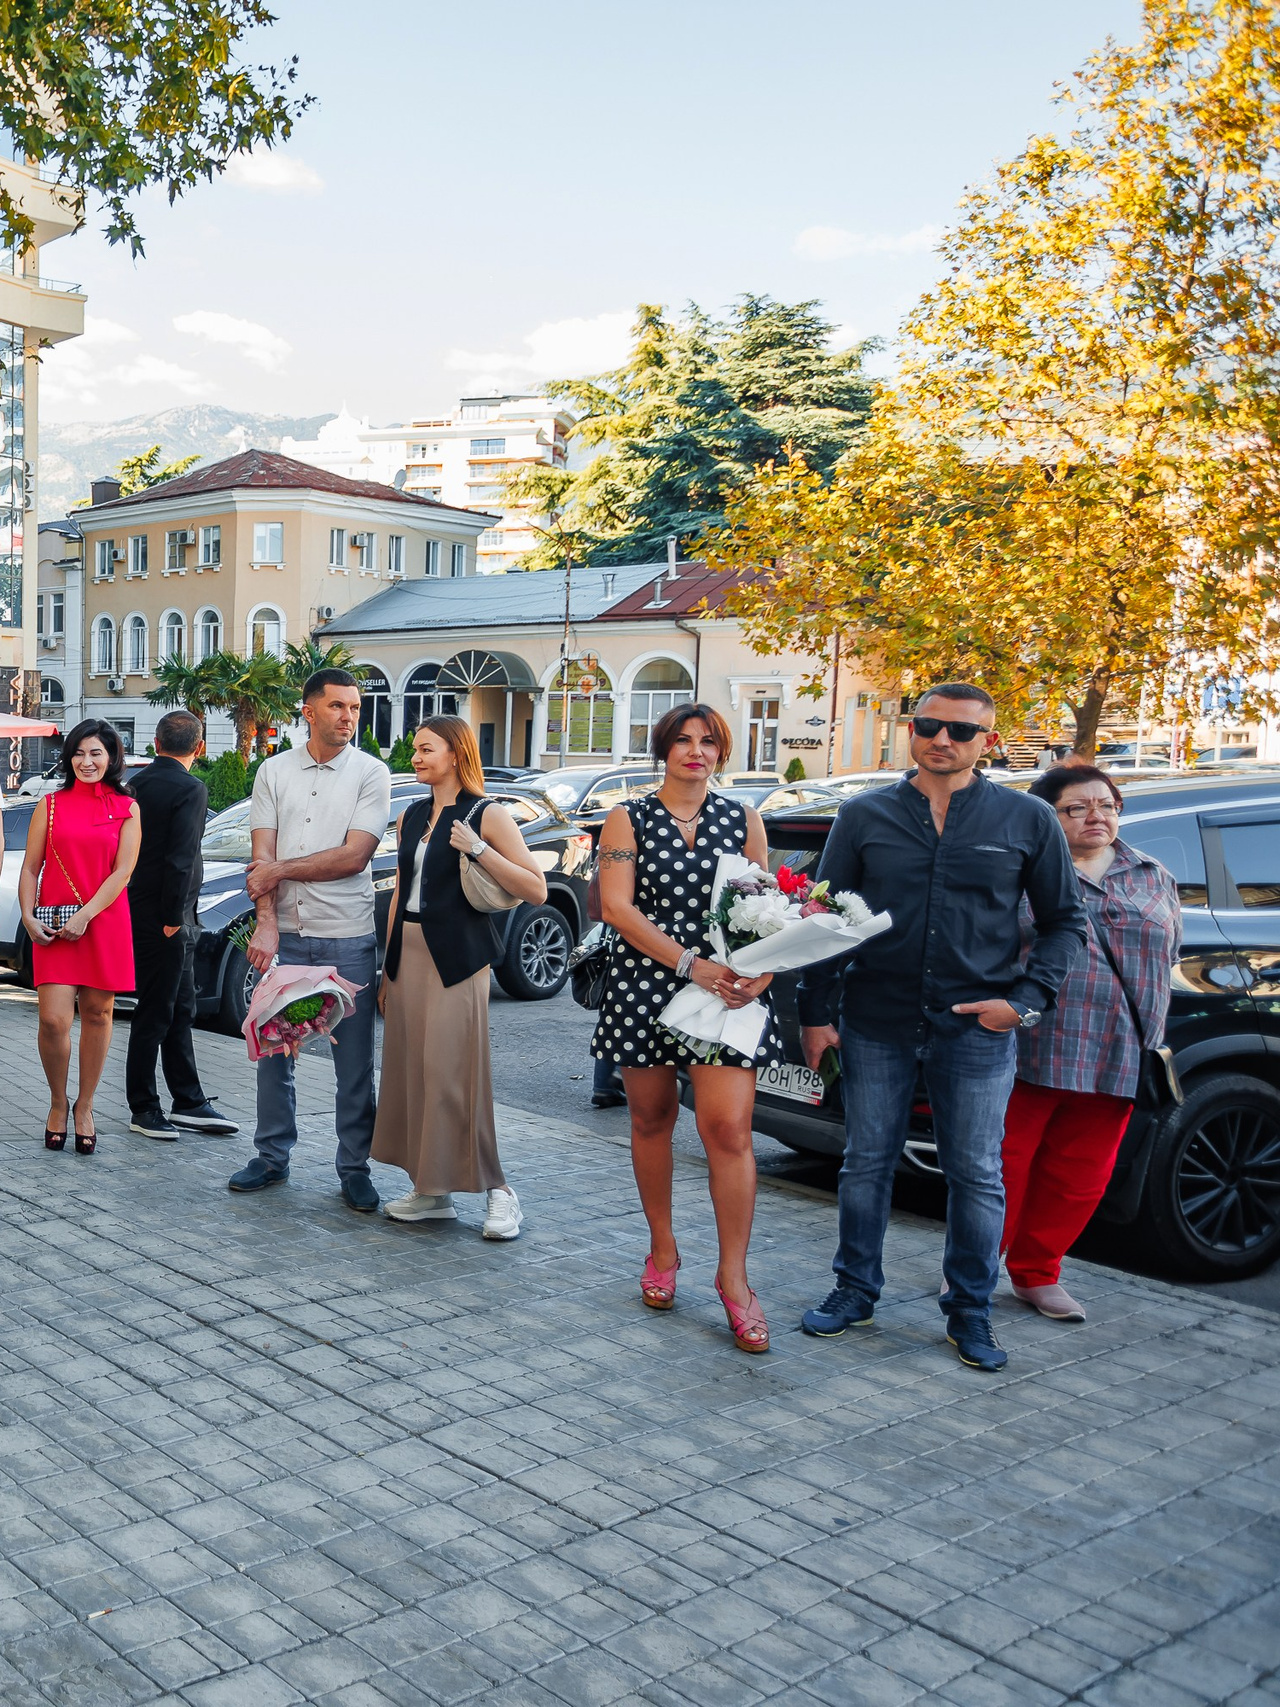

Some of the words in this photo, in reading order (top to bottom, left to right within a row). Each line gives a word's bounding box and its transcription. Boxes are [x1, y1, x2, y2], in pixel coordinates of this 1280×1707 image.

[7, 674, 22, 789] ROYLTA
[794, 1067, 820, 1088] 198
[797, 1085, 811, 1095] RUS
